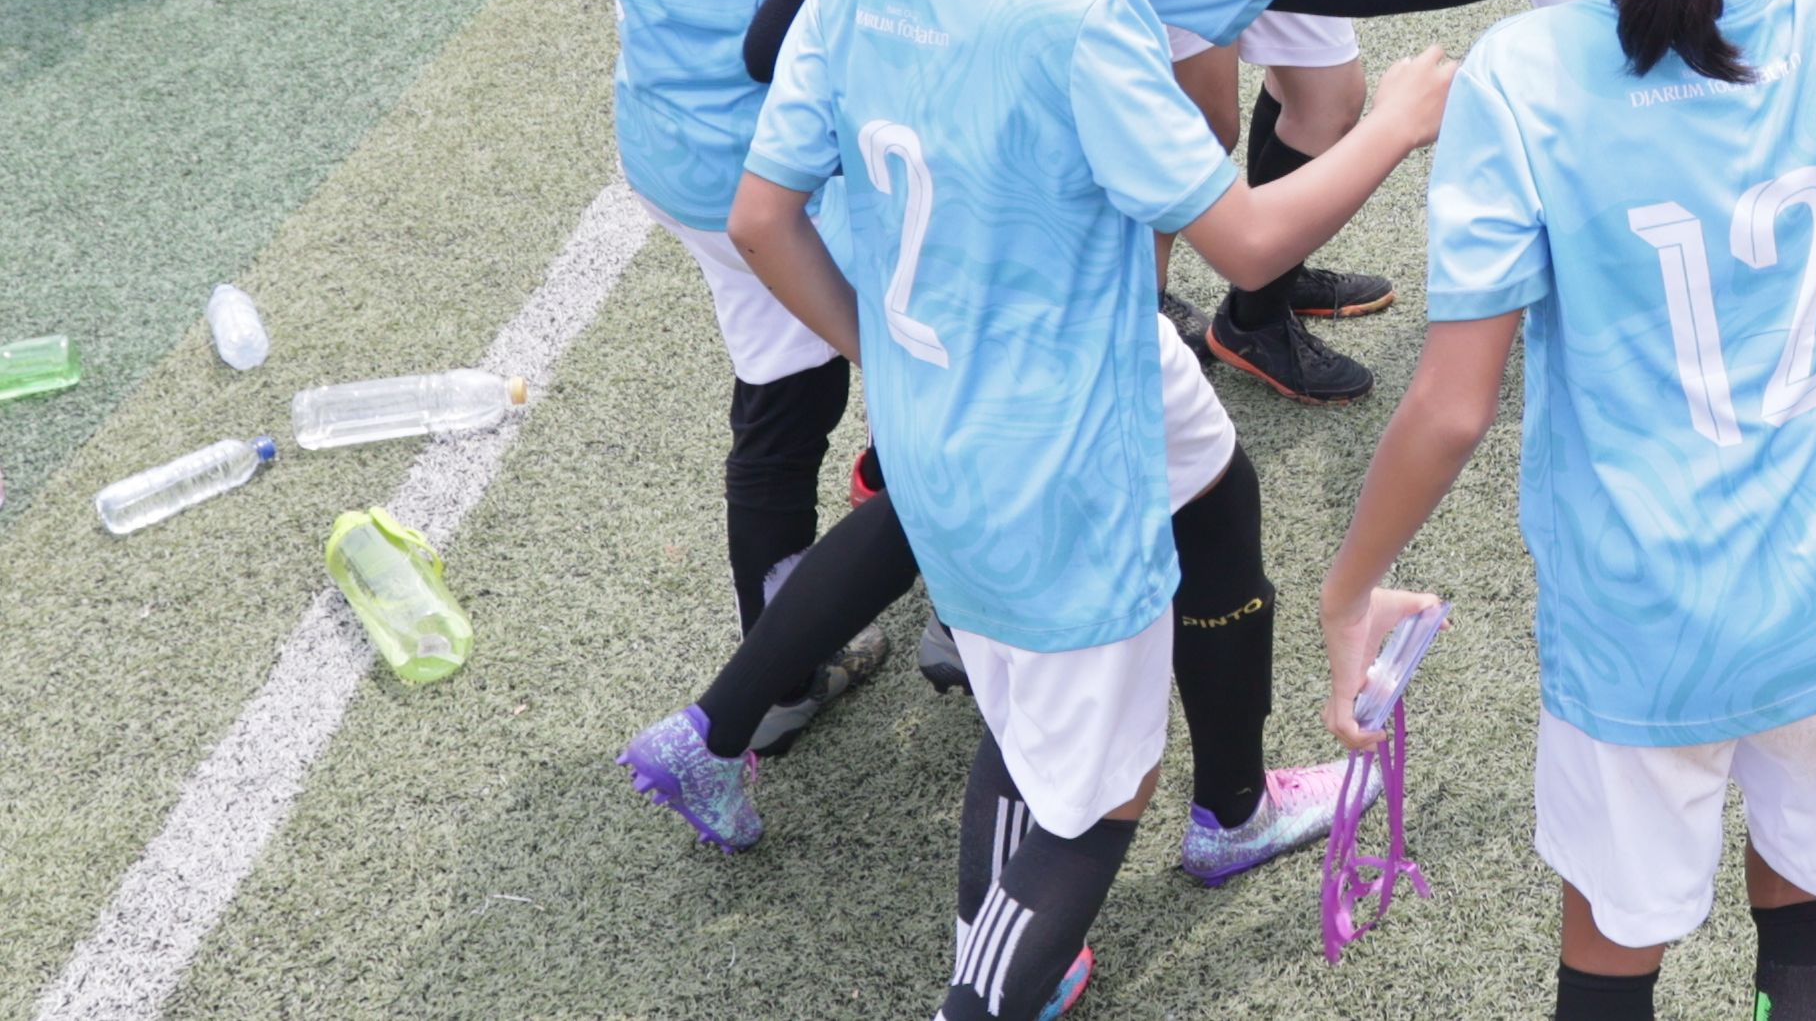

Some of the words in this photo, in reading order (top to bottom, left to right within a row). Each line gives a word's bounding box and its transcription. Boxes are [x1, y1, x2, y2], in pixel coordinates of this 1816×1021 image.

[1629, 81, 1705, 108] DJARUM
[857, 119, 949, 369] 2
[1182, 597, 1263, 629] PINTO
